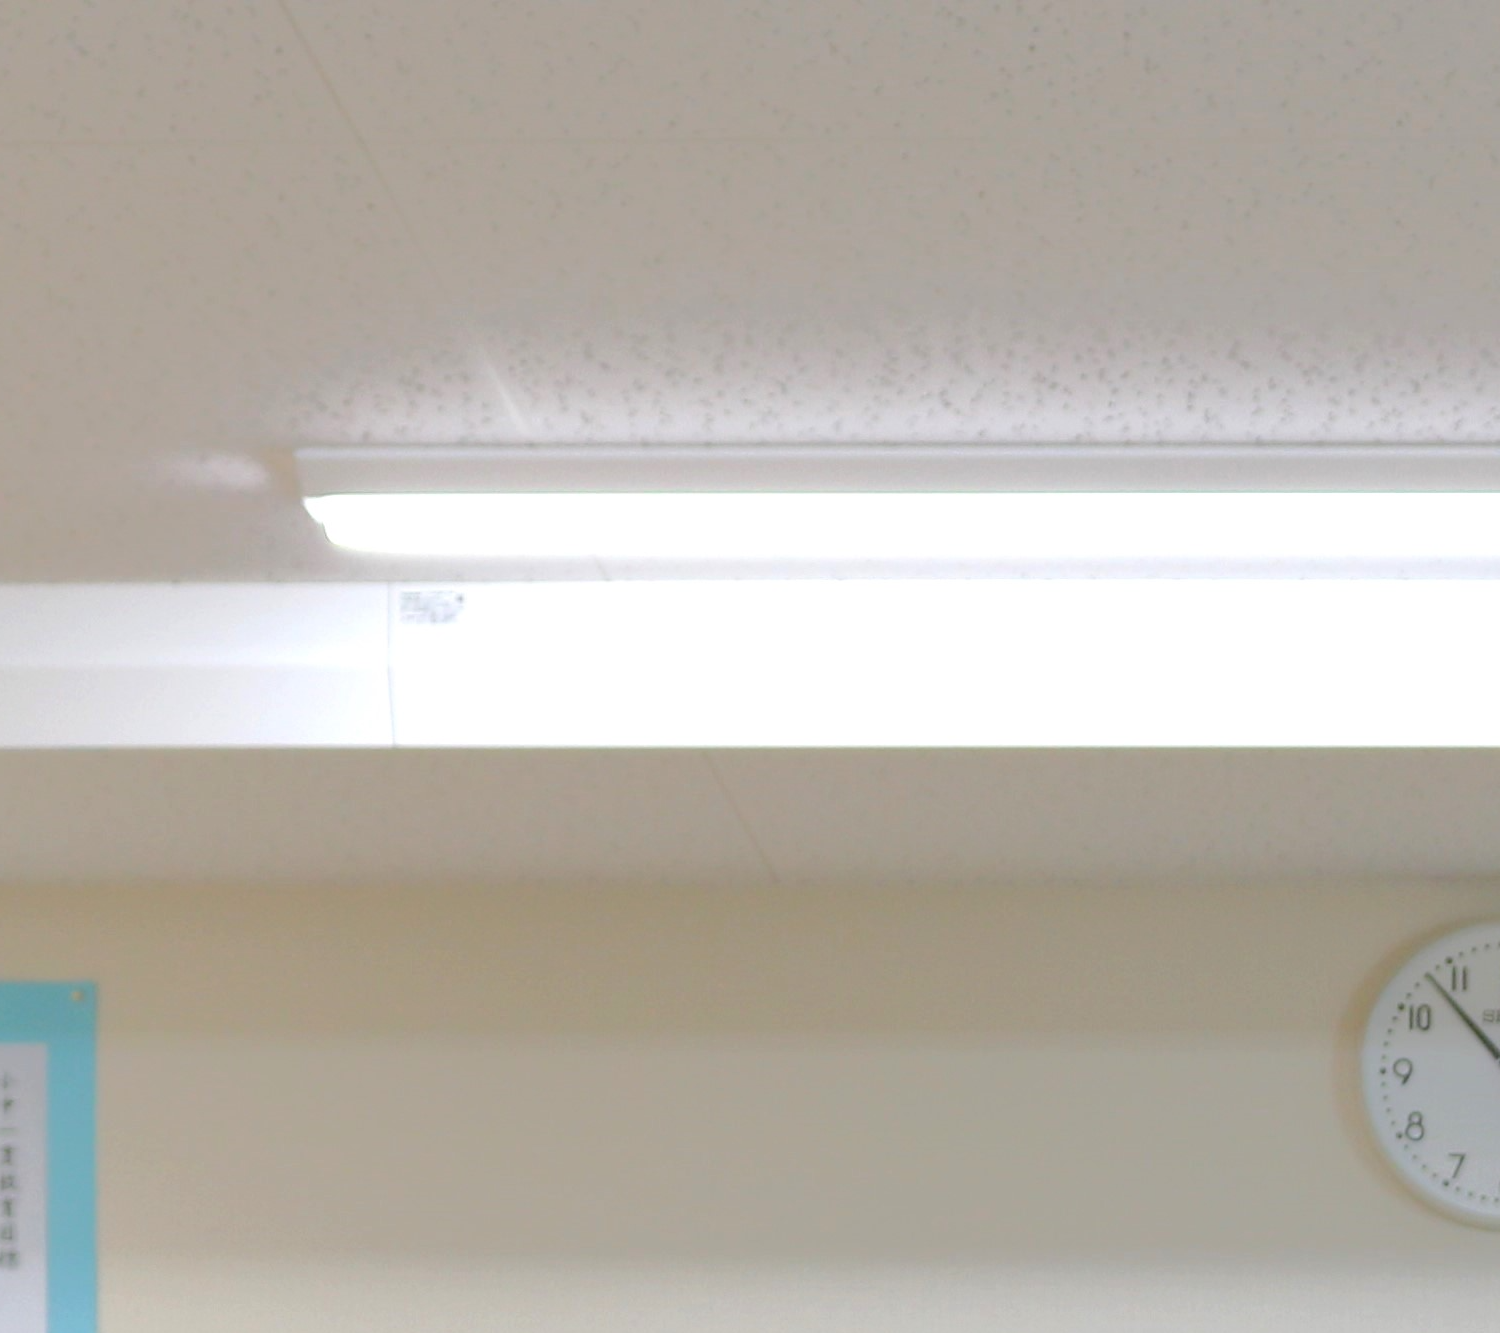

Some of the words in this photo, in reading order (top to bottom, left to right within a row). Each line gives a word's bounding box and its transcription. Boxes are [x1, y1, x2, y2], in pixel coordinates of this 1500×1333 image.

[1451, 966, 1468, 991] 11
[1409, 1004, 1432, 1031] 10
[1392, 1058, 1413, 1085] 9
[1405, 1111, 1425, 1141] 8
[1448, 1153, 1466, 1179] 7
